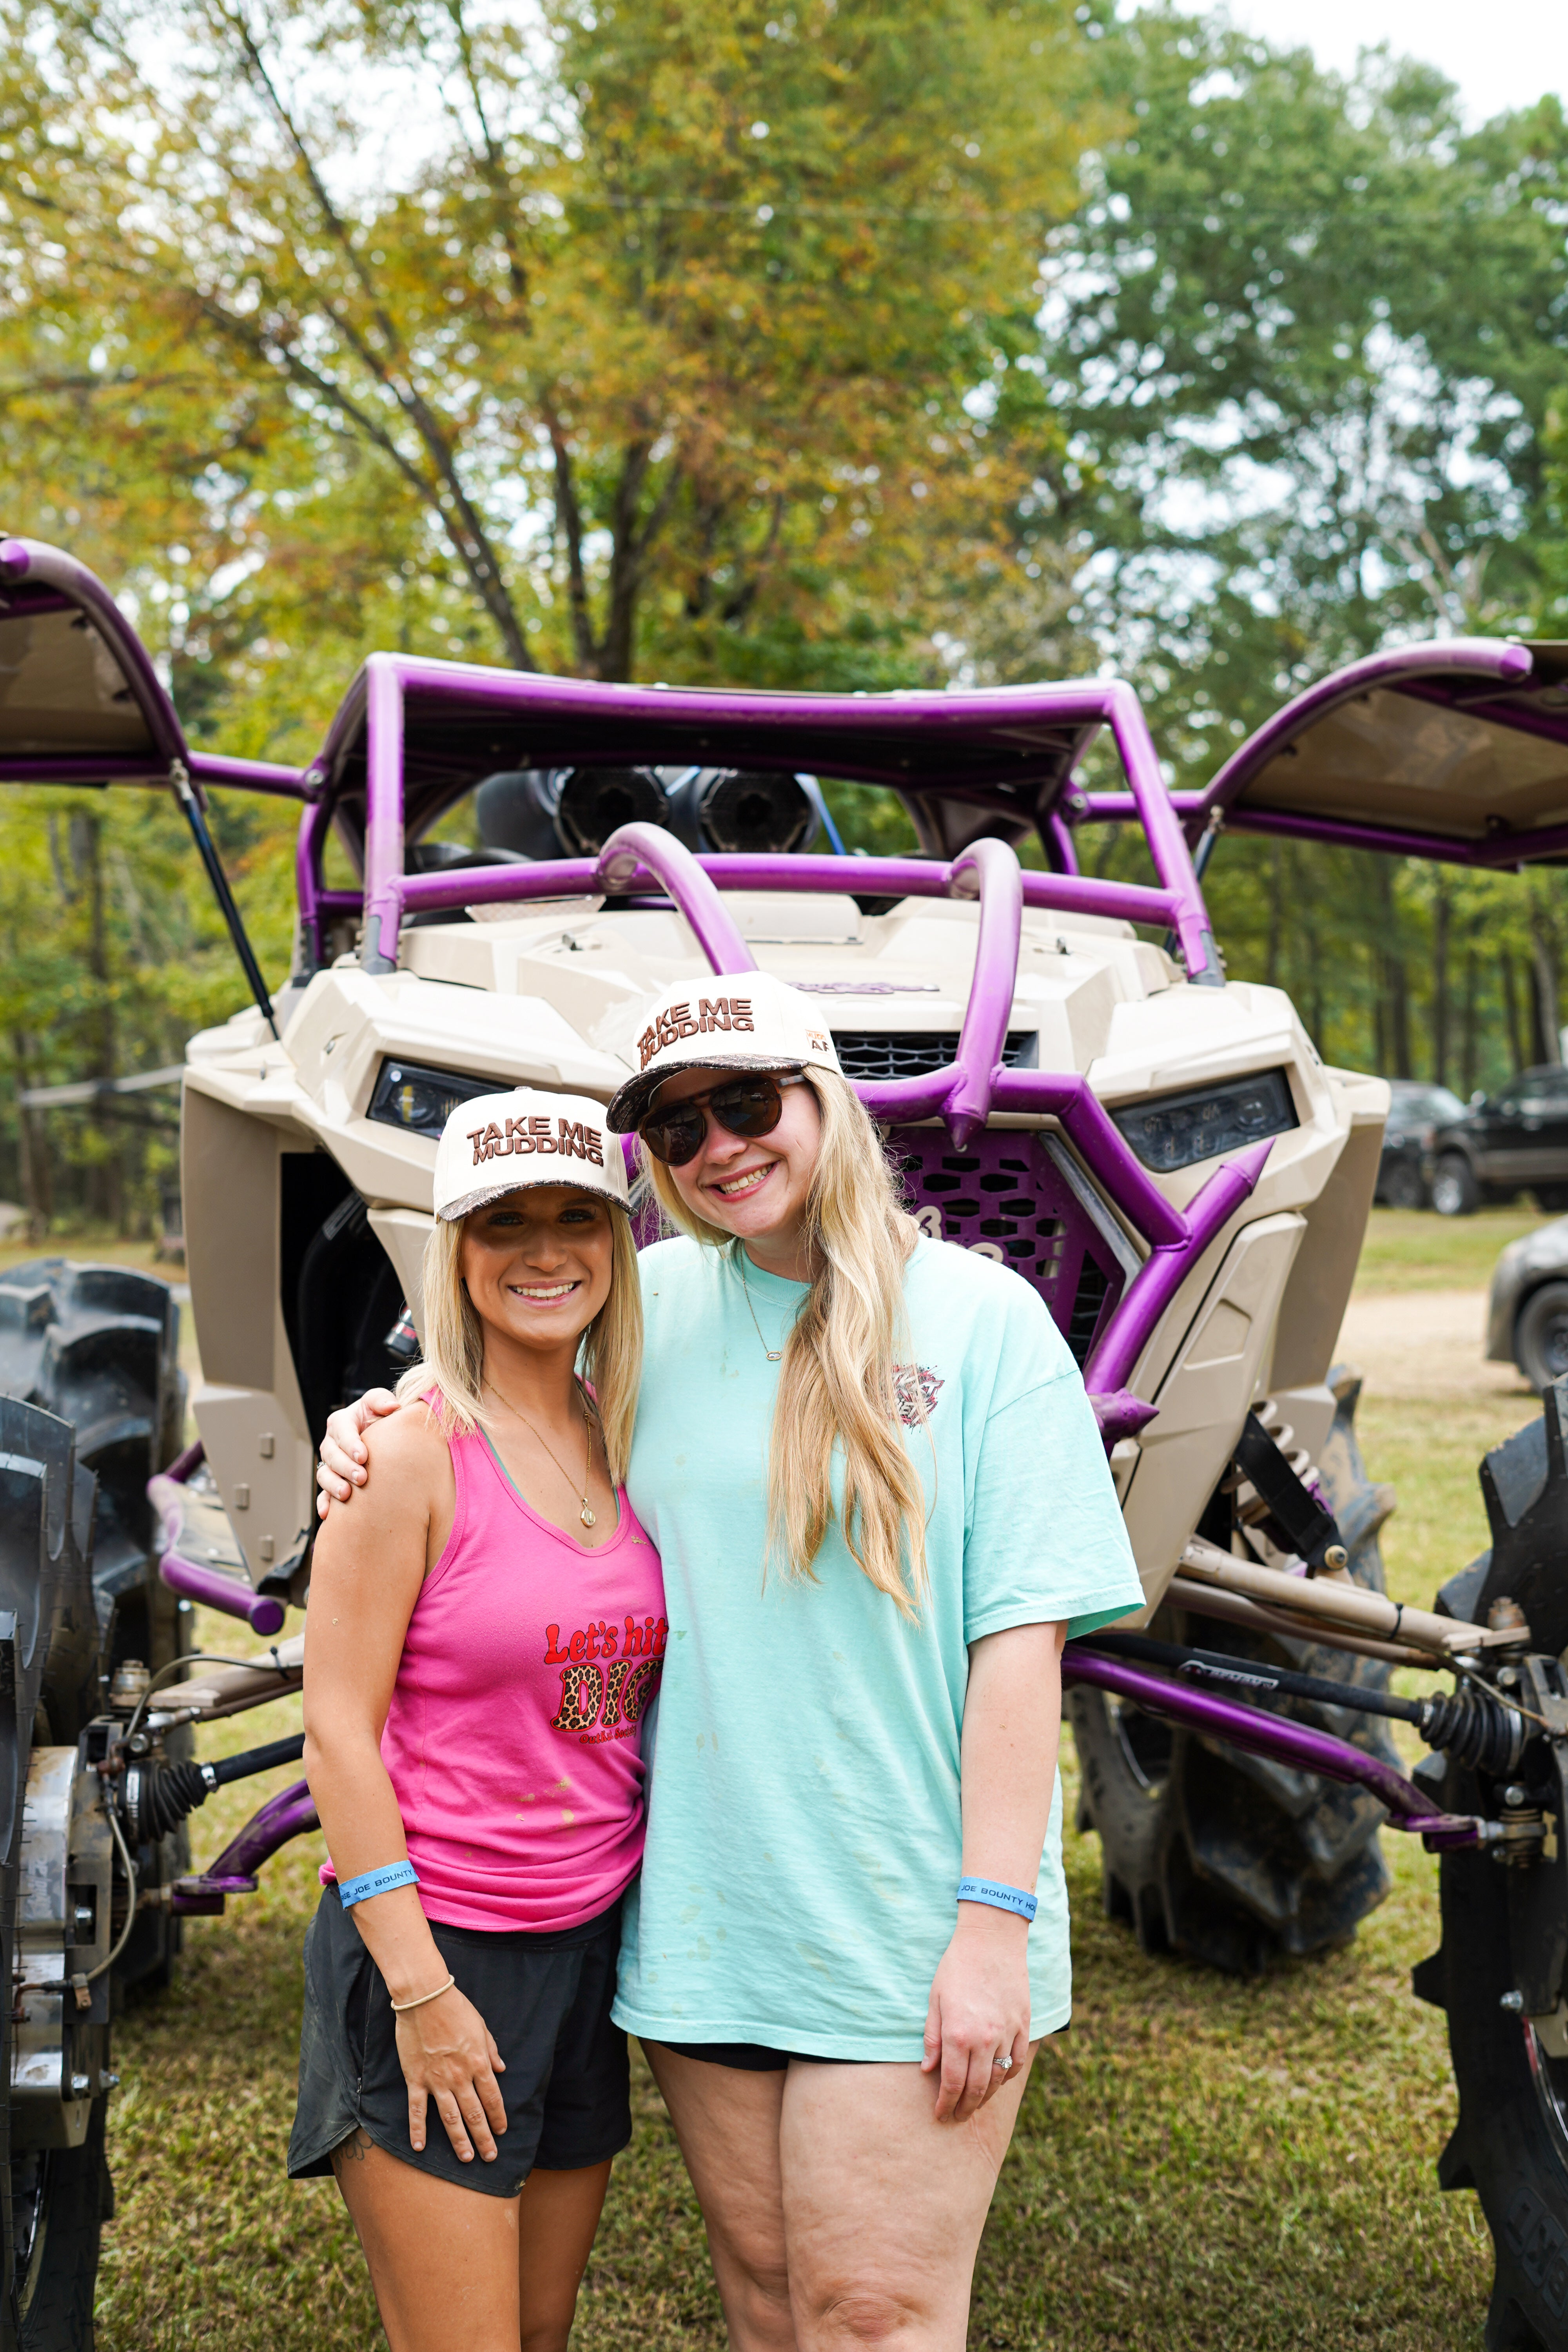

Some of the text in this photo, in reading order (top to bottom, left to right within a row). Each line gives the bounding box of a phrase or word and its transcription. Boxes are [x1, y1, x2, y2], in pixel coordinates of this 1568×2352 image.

[637, 998, 753, 1054] TAKE ME
[641, 1015, 754, 1071] MUDDING
[466, 1116, 603, 1149] TAKE ME
[473, 1136, 603, 1167] MUDDING
[544, 1616, 669, 1664] Let's hit
[354, 1883, 371, 1895] JOE
[374, 1869, 413, 1886] BOUNTY
[981, 1888, 1024, 1905] BOUNTY
